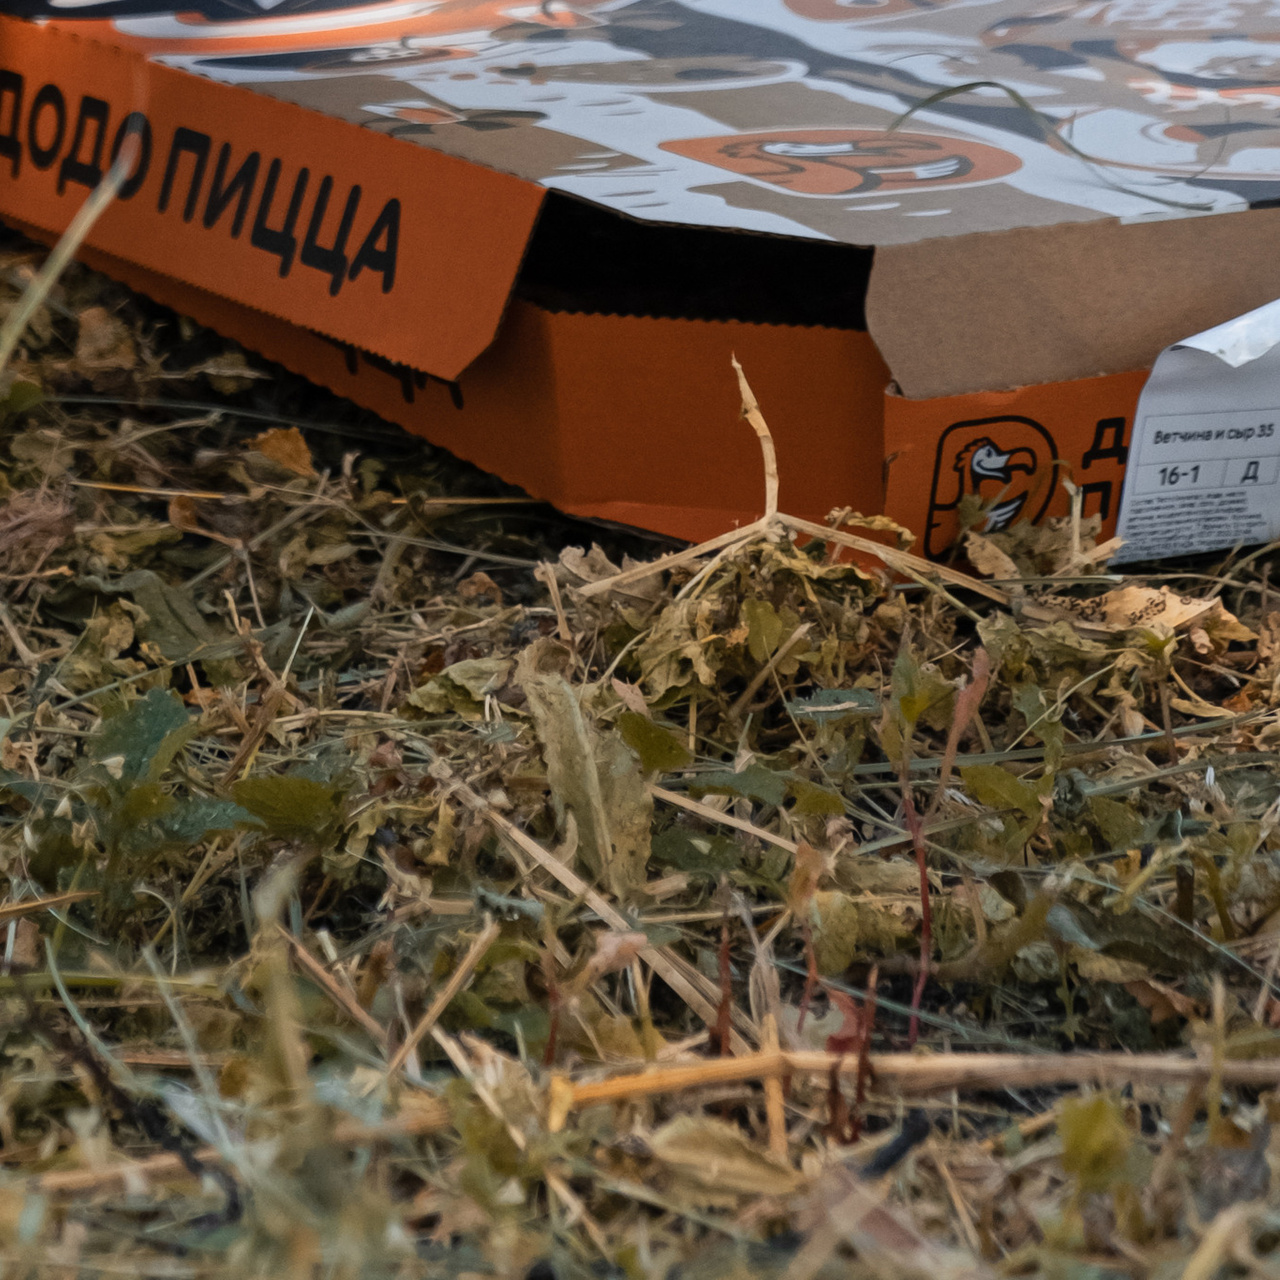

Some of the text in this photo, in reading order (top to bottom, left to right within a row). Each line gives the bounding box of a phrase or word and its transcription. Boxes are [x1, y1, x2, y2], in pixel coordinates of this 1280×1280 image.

[158, 126, 400, 296] ПИЦЦА
[1154, 423, 1275, 445] Ветчина и сыр 35
[1159, 460, 1260, 486] 16-1 Д
